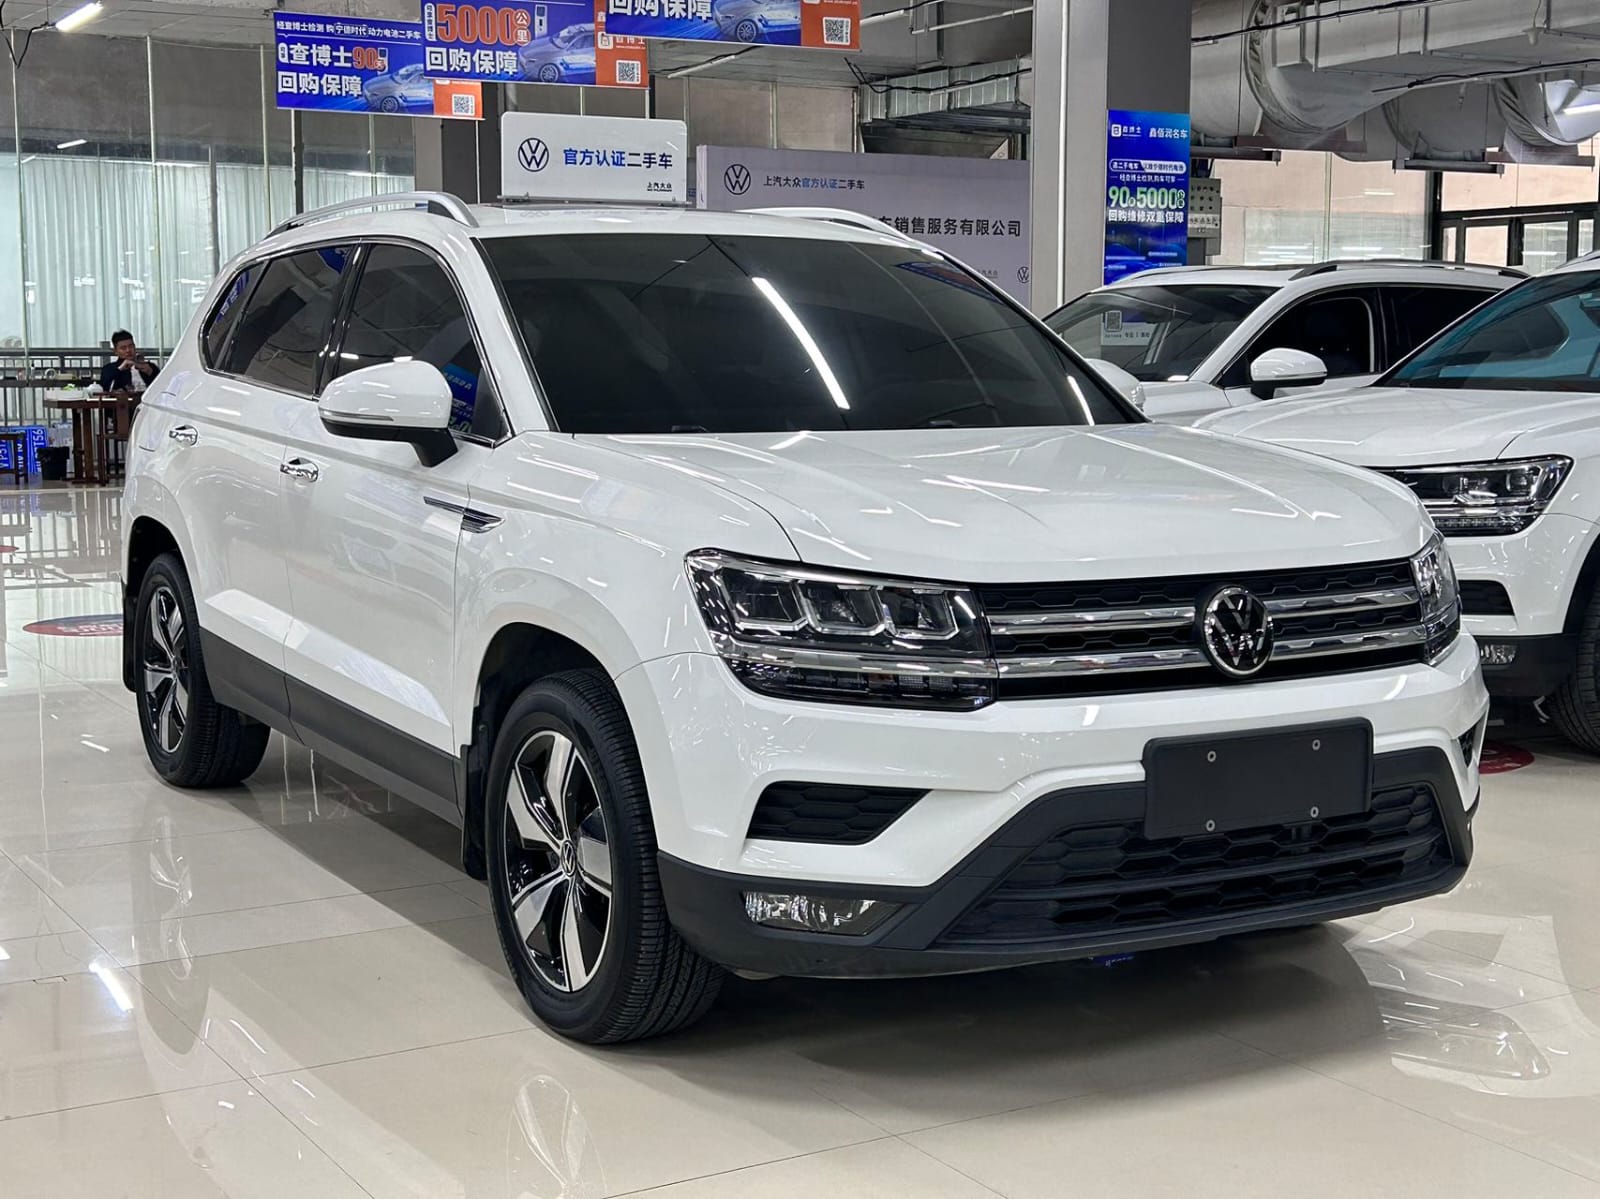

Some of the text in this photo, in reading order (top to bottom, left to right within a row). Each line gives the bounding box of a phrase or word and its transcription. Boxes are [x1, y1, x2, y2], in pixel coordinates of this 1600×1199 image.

[609, 0, 713, 21] 回购保障
[425, 47, 518, 75] 回购保障
[277, 71, 362, 97] 回购保障
[563, 148, 673, 169] 官方认证二手车
[763, 175, 865, 190] 上汽大众官方认证二手车
[1108, 210, 1185, 223] 回购维修双重保障
